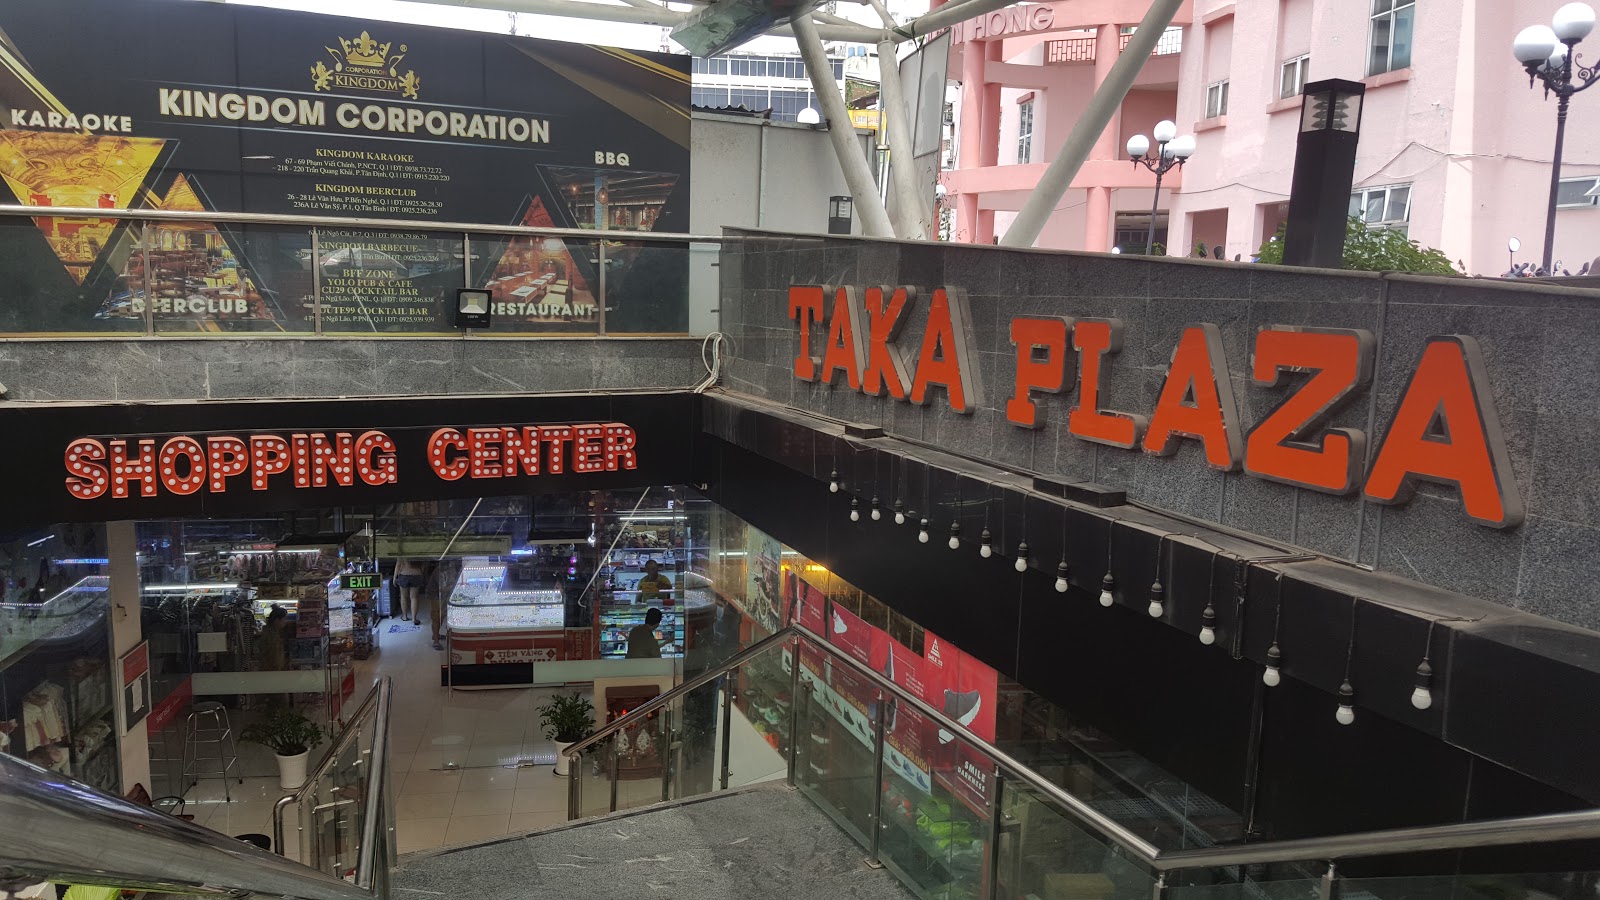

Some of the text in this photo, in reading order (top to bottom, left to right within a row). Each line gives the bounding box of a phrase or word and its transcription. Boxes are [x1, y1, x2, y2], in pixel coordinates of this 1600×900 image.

[974, 6, 1054, 40] HONG
[345, 66, 388, 76] CORPORATION
[336, 75, 398, 90] KINGDOM
[11, 108, 132, 132] KARAOKE
[159, 88, 550, 144] KINGDOM CORPORATION
[316, 148, 414, 162] KINGDOM KARAOKE
[595, 151, 630, 166] BBQ
[315, 184, 416, 196] KINGDOM BEERCLUB
[318, 242, 418, 252] KINGDOM BARBECUE
[343, 269, 395, 279] BFF ZONE
[347, 287, 397, 295] COCKTAIL
[399, 288, 418, 296] BAR
[788, 284, 1526, 529] TAKA PLAZA
[64, 422, 637, 500] SHOPPING CENTER
[350, 576, 372, 587] EXIT
[958, 766, 985, 792] DARKNESS
[964, 761, 986, 783] SMILE
